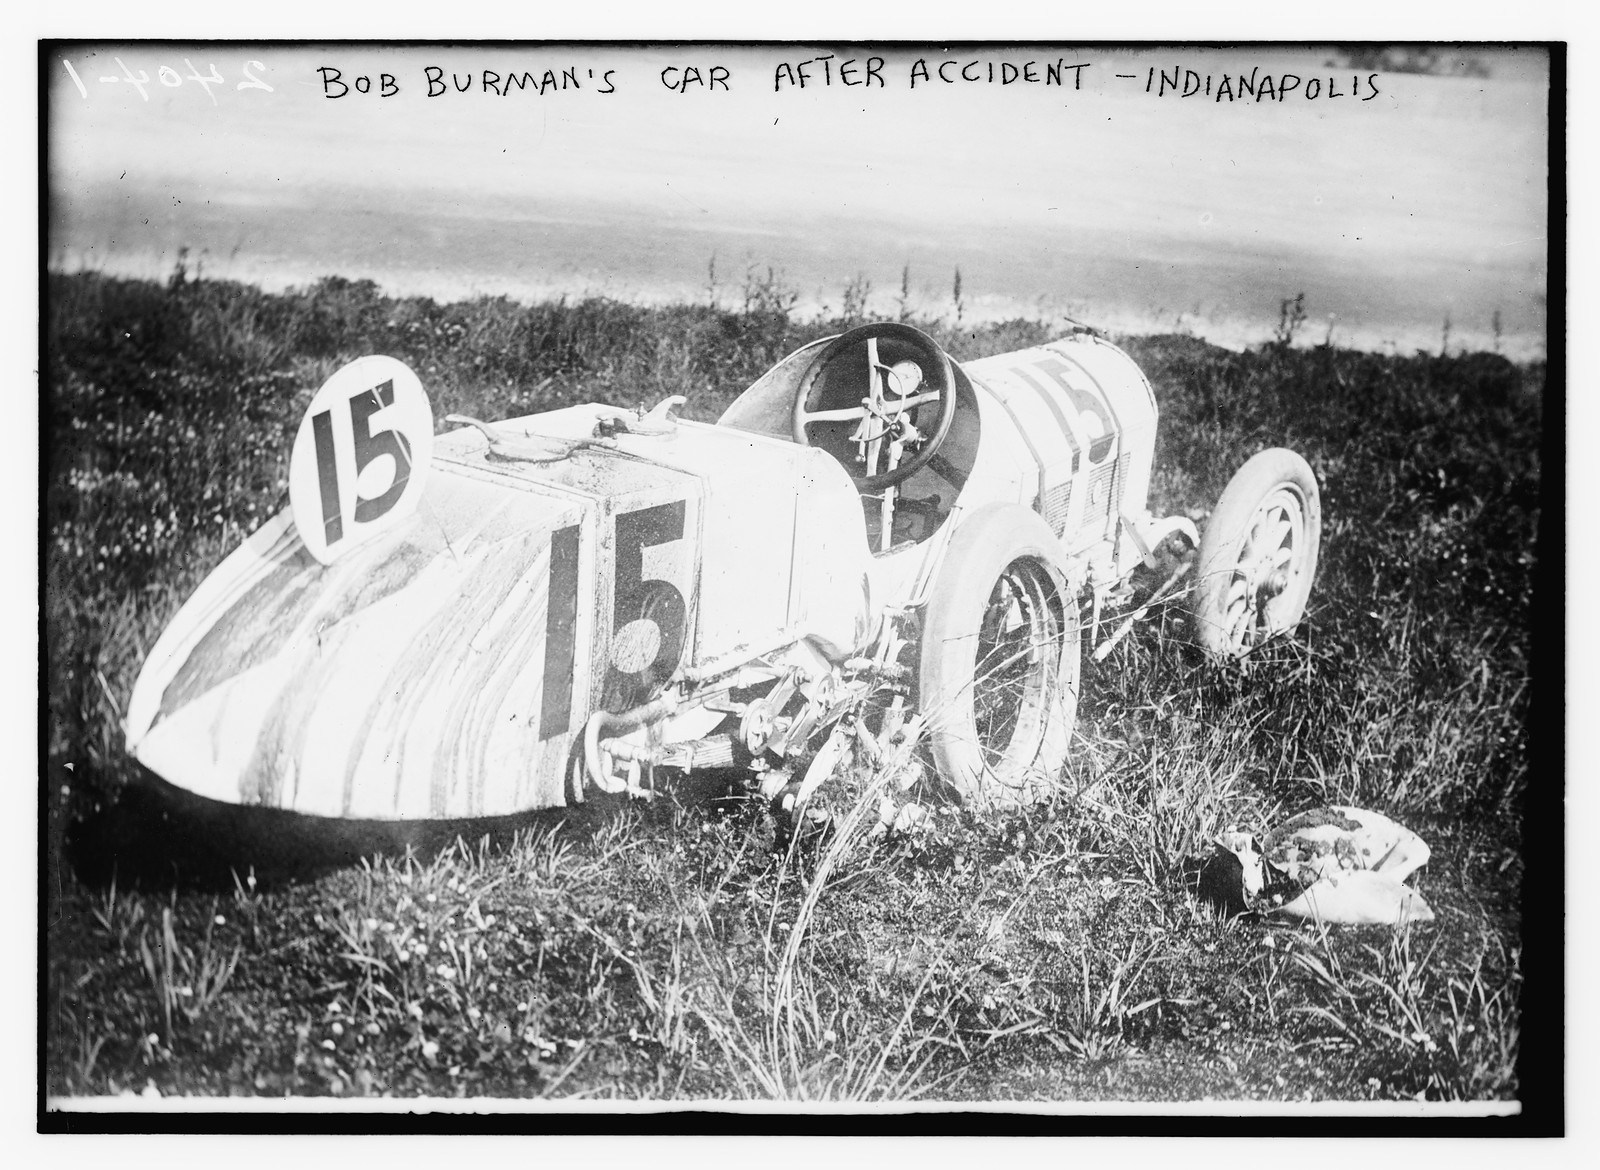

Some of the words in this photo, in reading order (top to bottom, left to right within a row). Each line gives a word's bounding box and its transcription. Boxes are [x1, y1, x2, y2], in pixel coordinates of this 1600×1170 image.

[311, 377, 413, 547] 15
[1008, 357, 1117, 475] 15
[539, 498, 688, 743] 15
